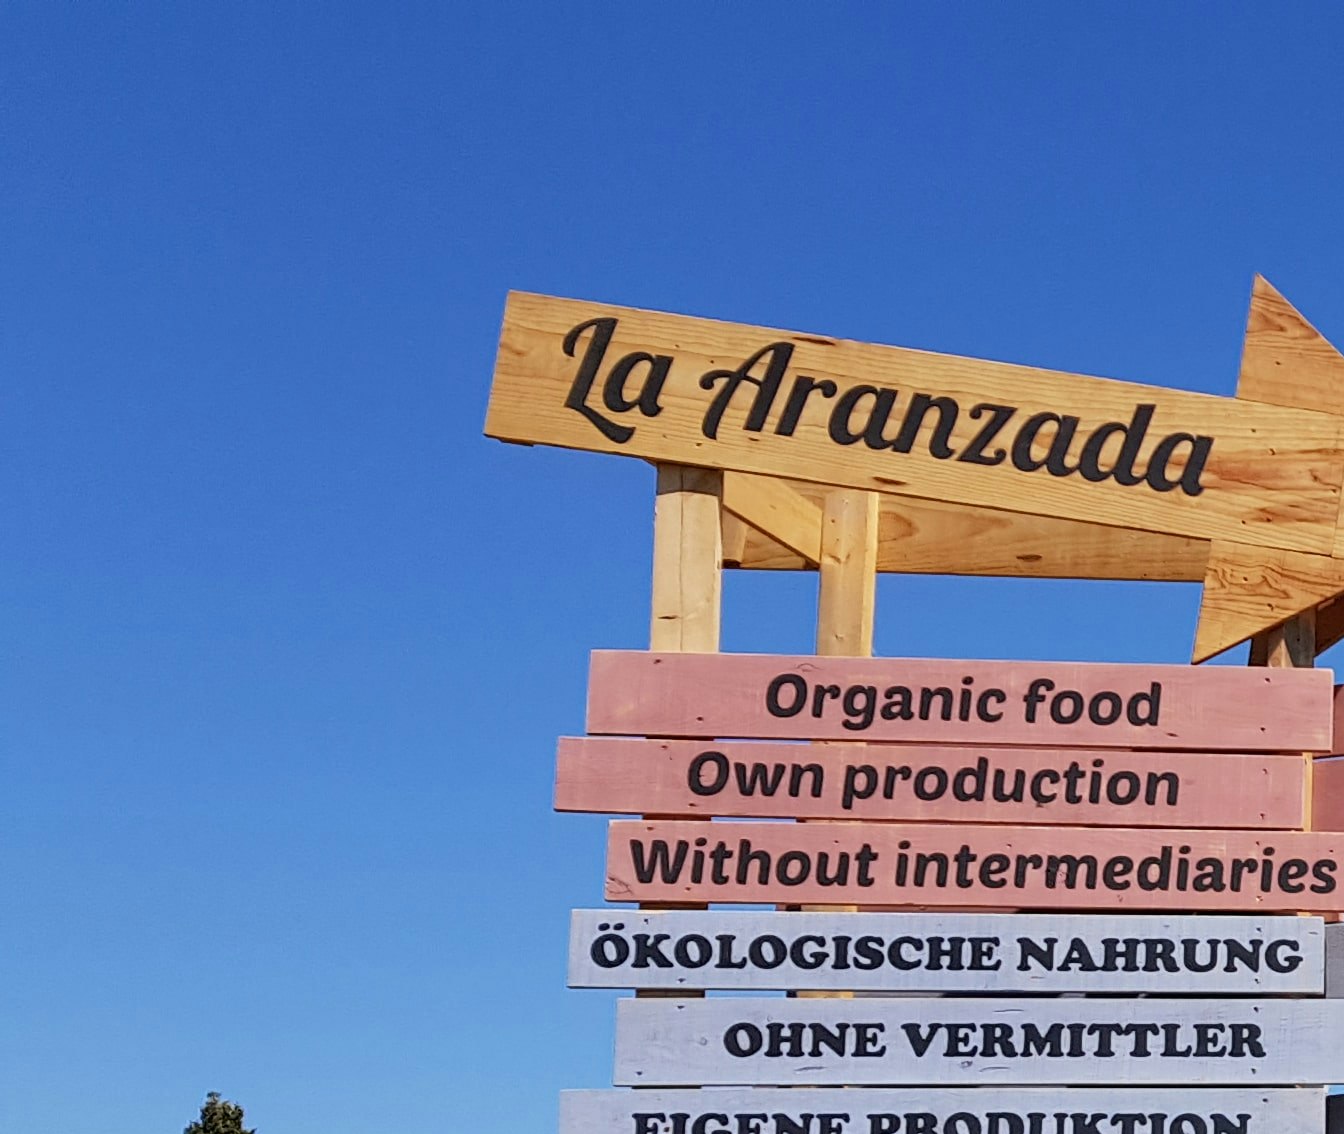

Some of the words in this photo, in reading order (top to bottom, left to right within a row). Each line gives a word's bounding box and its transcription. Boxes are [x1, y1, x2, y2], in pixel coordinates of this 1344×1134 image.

[562, 317, 674, 444] La
[699, 340, 1214, 497] Aranzada
[765, 673, 1007, 732] Organic
[1022, 678, 1162, 727] food
[687, 750, 824, 799] Own
[841, 756, 1180, 811] production
[629, 837, 879, 888] Without
[894, 840, 1338, 895] intermediaries
[590, 922, 1002, 972] ÖKOLOGISCHE
[1016, 937, 1304, 974] NAHRUNG
[723, 1022, 887, 1058] OHNE
[900, 1022, 1267, 1058] VERMITTLER
